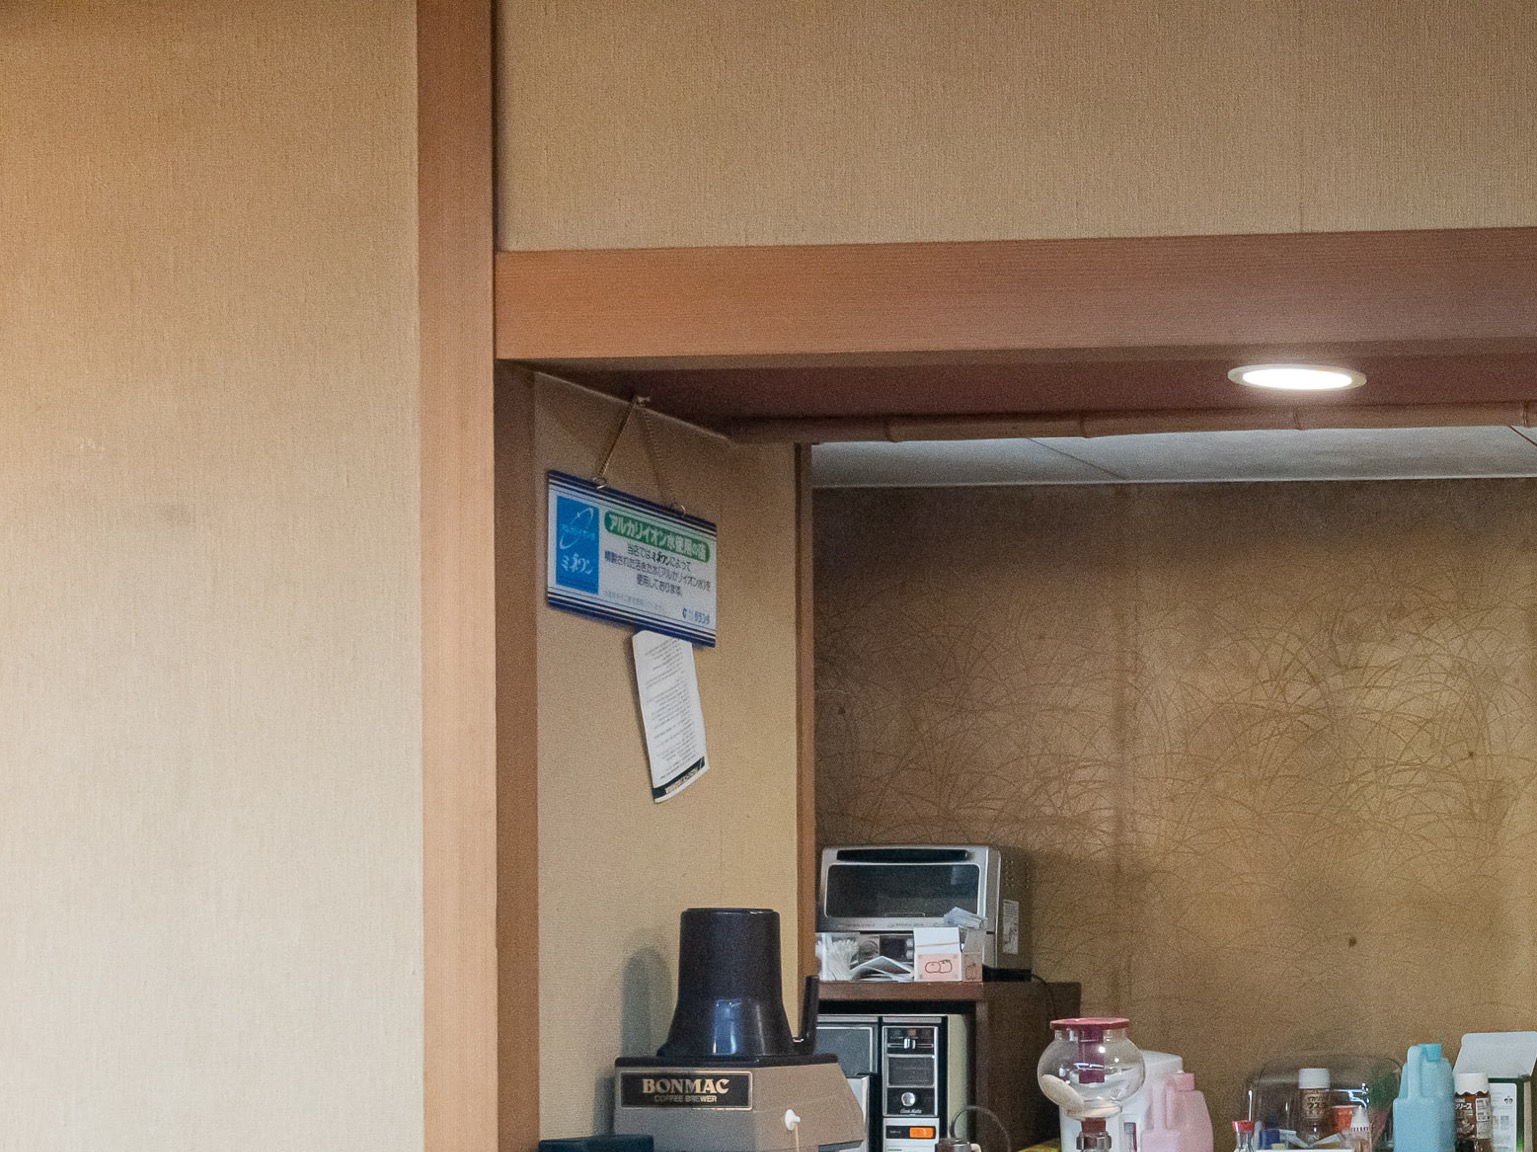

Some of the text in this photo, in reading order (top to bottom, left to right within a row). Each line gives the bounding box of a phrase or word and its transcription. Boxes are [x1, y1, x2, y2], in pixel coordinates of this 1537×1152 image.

[642, 1078, 730, 1094] BONMAC
[654, 1095, 717, 1103] COFFEE BREWER
